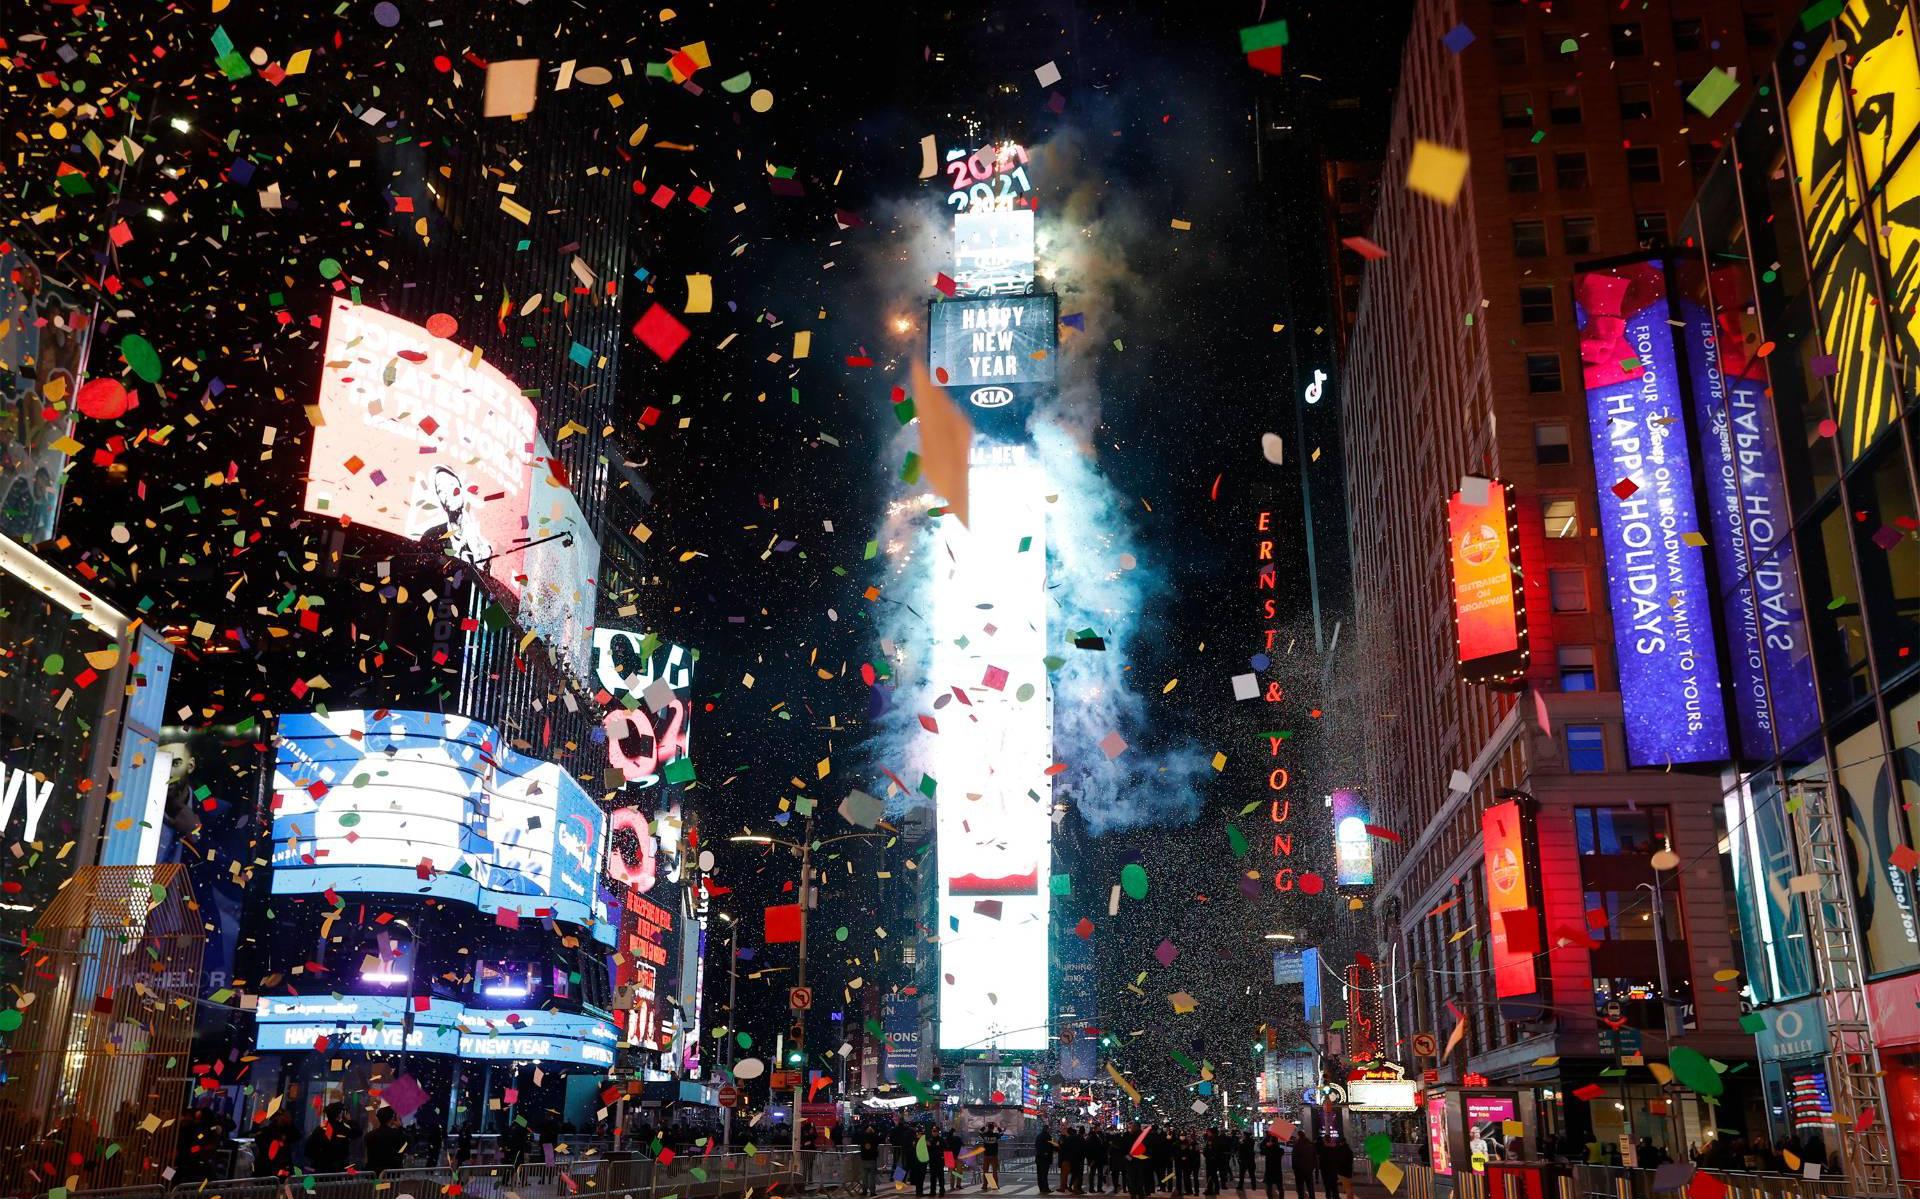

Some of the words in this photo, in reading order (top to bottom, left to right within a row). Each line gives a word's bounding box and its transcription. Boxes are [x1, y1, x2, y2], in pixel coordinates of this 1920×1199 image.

[947, 144, 1028, 190] 201
[961, 306, 1024, 329] HAPPY
[972, 331, 1014, 353] NEW
[1636, 325, 1656, 366] FROM
[968, 356, 1017, 377] YEAR
[977, 391, 1007, 403] KIA
[1643, 371, 1659, 404] OUR
[1655, 467, 1672, 496] ON
[1657, 496, 1684, 584] BROADWAY
[1258, 512, 1279, 650] ERNST
[1620, 498, 1667, 655] HOLIDAYS
[1671, 589, 1692, 644] FAMILY
[1680, 648, 1695, 671] TO
[1264, 681, 1282, 702] &
[1269, 736, 1294, 891] YOUNG
[475, 1039, 511, 1054] NEW
[511, 1040, 550, 1055] YEAR
[1773, 1039, 1812, 1057] OAKLEY
